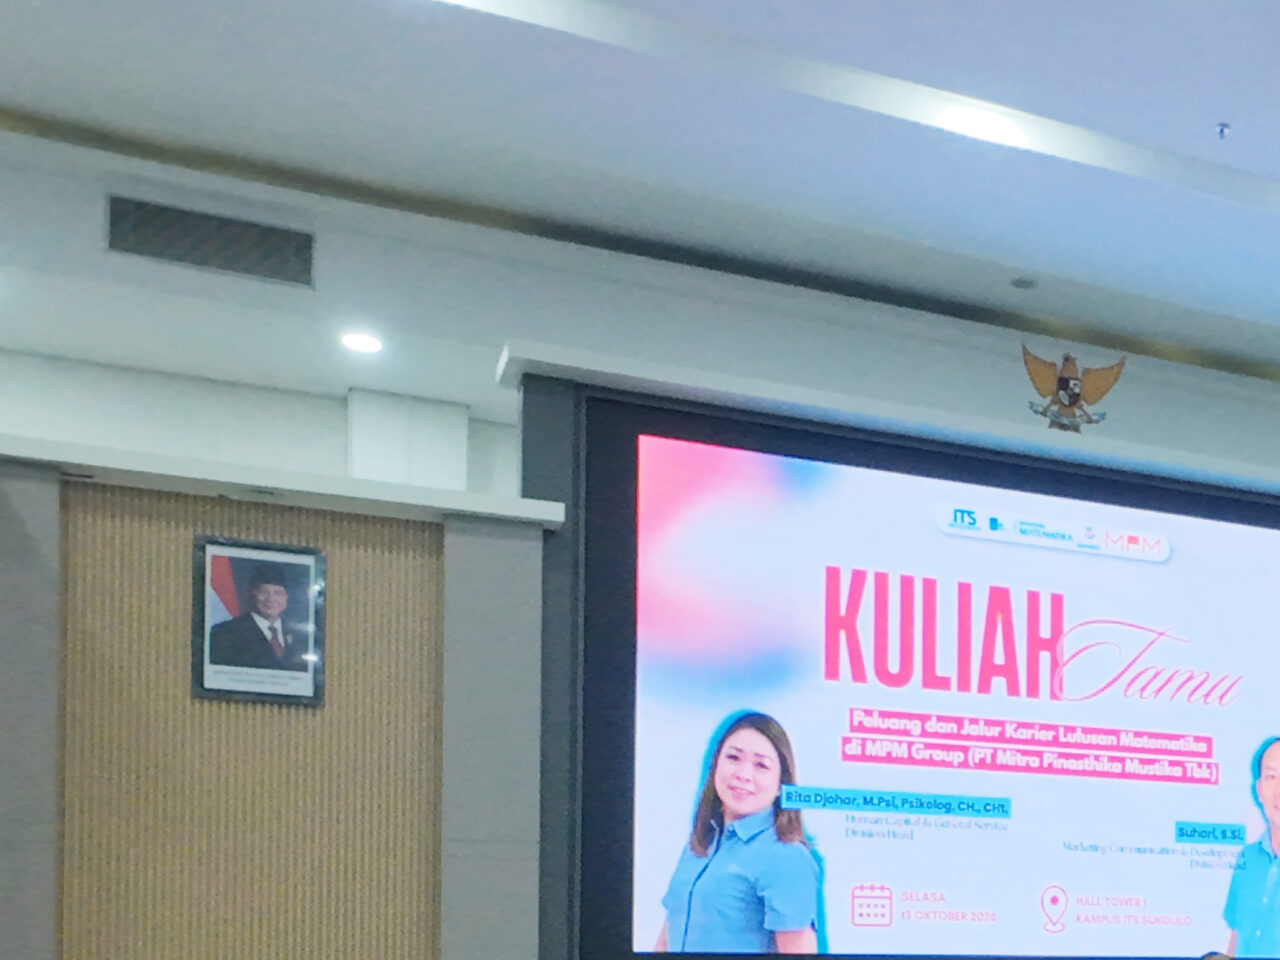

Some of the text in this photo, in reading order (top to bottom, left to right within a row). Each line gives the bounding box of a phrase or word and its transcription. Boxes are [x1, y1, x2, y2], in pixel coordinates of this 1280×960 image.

[954, 509, 977, 526] ITS
[1105, 532, 1161, 556] MPM
[824, 565, 1064, 701] KULIAH
[1054, 619, 1245, 707] Tamu
[853, 710, 1208, 753] Peluang dan Jalur Karier Lulusan Matematika
[845, 739, 1217, 783] di MPM Group (PT Mitra Pinasthika Mustika Tbk)
[786, 791, 811, 803] Rita
[814, 792, 860, 807] Djohar,
[901, 891, 946, 902] SELASA
[1076, 896, 1102, 907] HALL
[1105, 897, 1141, 907] TOWER
[914, 911, 967, 922] OKTOBER
[1076, 914, 1121, 925] KAMPUS
